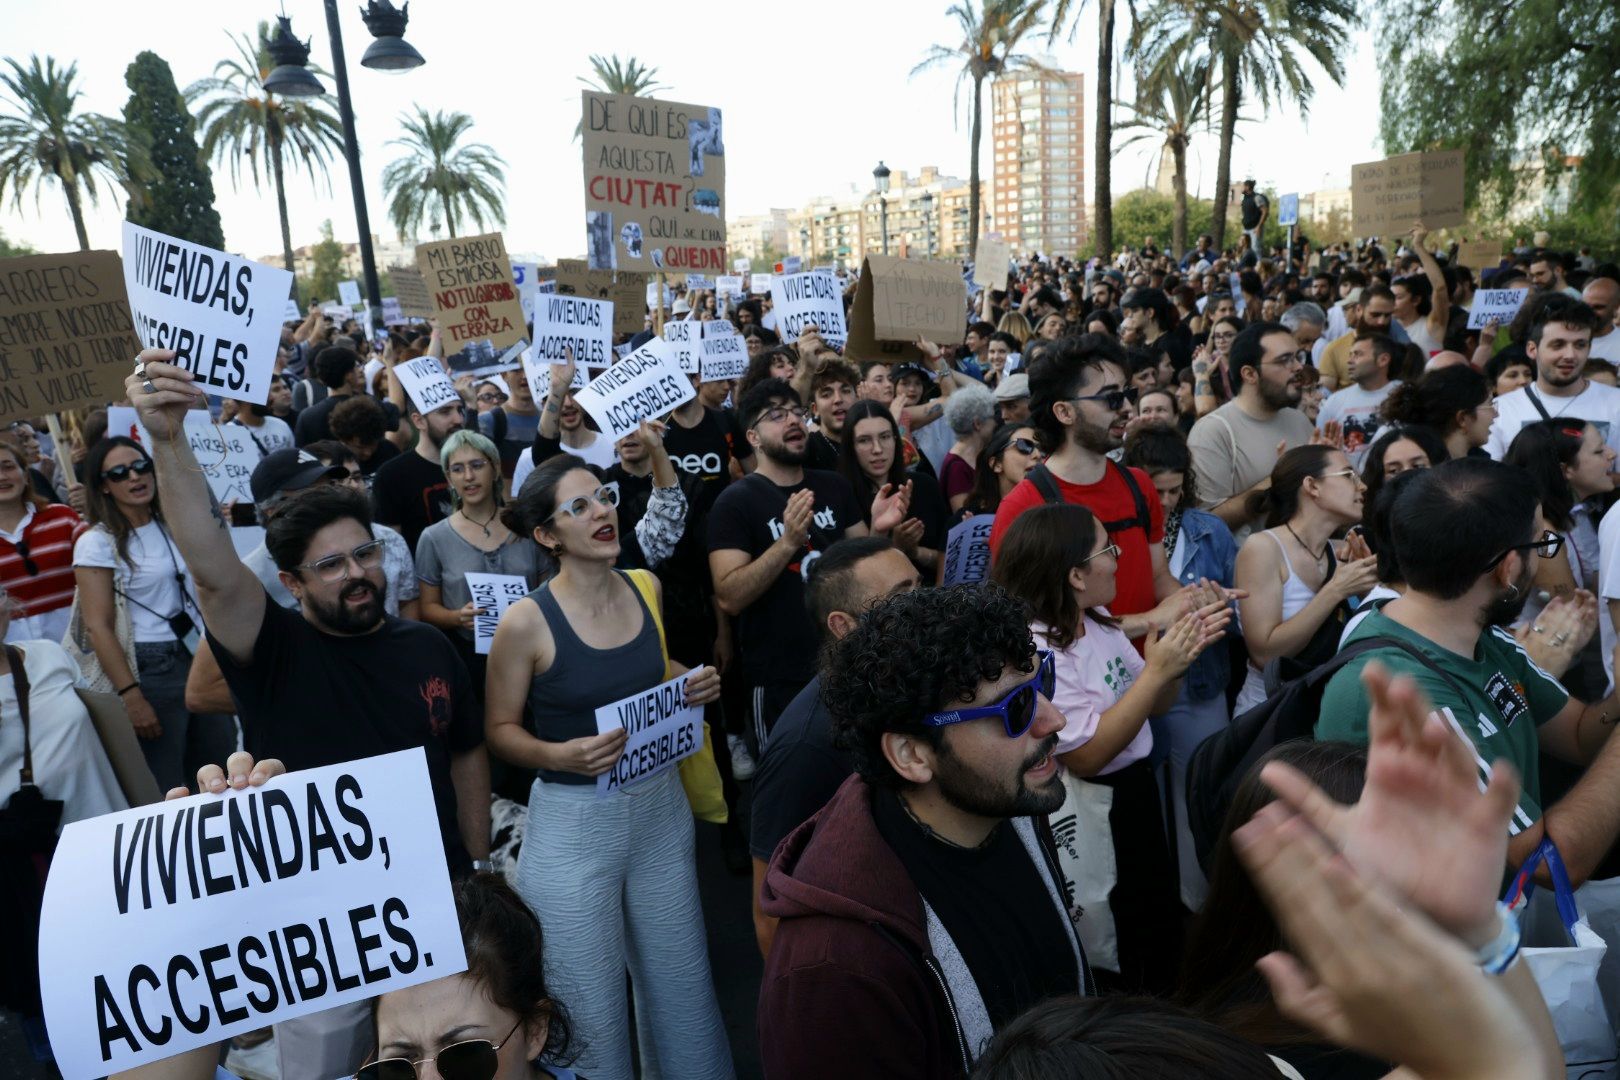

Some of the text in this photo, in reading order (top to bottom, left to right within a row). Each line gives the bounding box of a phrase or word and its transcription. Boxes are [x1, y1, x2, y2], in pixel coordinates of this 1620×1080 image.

[590, 97, 617, 132] DE
[599, 145, 675, 175] AQUESTA
[427, 239, 501, 269] MI BARRIO
[135, 232, 254, 328] VIVIENDAS,
[56, 300, 134, 340] NOSTRES
[447, 316, 514, 341] TERRAZA
[463, 305, 491, 323] CON
[548, 297, 603, 332] VIVIENDAS,
[895, 301, 946, 327] TECHO
[590, 348, 665, 397] VIVIENDAS,
[605, 374, 687, 435] ACCESIBLES.
[607, 722, 696, 791] ACCESIBLES.
[113, 774, 391, 915] VIVIENDAS,
[94, 897, 434, 1062] ACCESIBLES.
